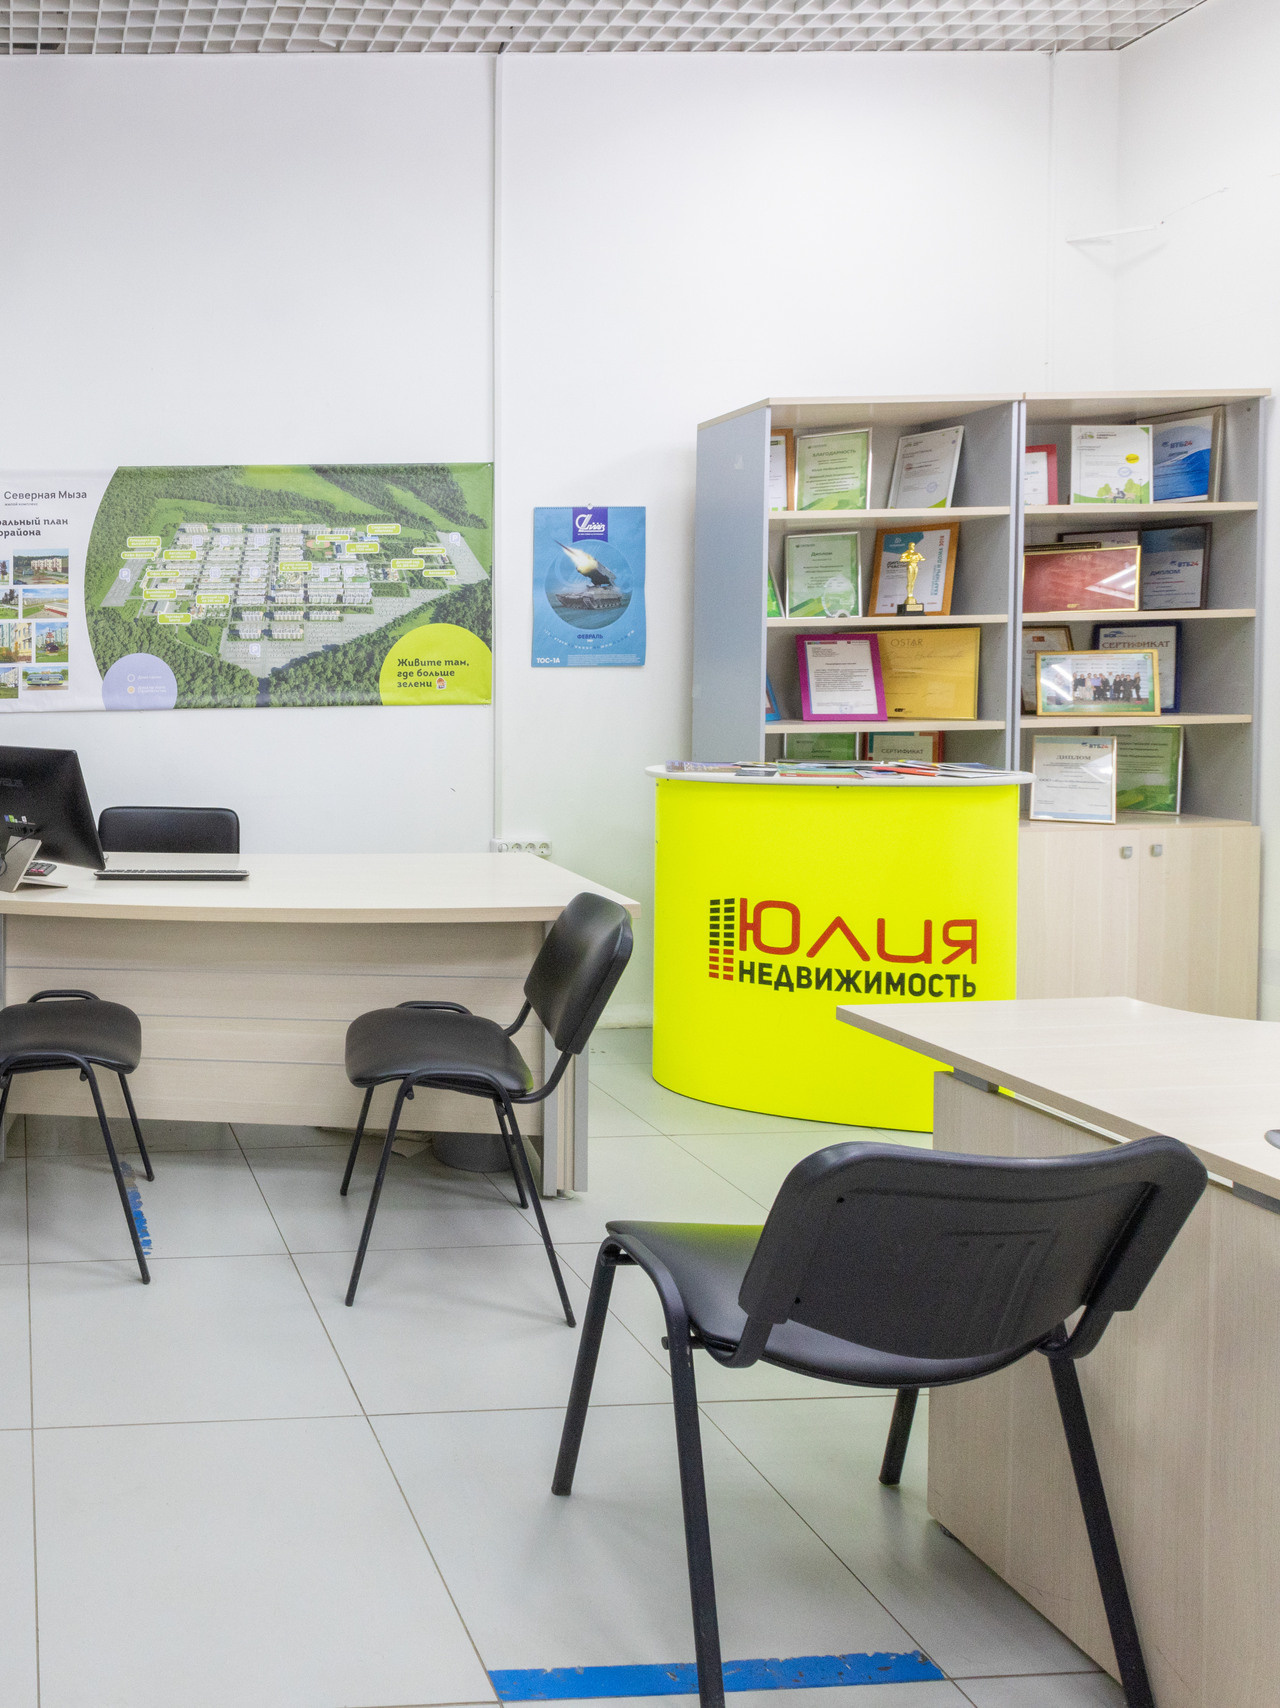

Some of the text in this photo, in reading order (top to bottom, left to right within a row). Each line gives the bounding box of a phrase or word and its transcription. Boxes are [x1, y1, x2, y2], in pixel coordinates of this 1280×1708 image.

[4, 490, 88, 502] Северная Мыза
[43, 518, 69, 526] план
[890, 638, 923, 647] OSTAR
[1102, 640, 1170, 649] СЕРТИФИКАТ
[397, 657, 471, 669] Живите там,
[397, 668, 456, 679] где больше
[397, 680, 433, 689] зелени
[738, 961, 977, 998] НЕДВИЖИМОСТЬ
